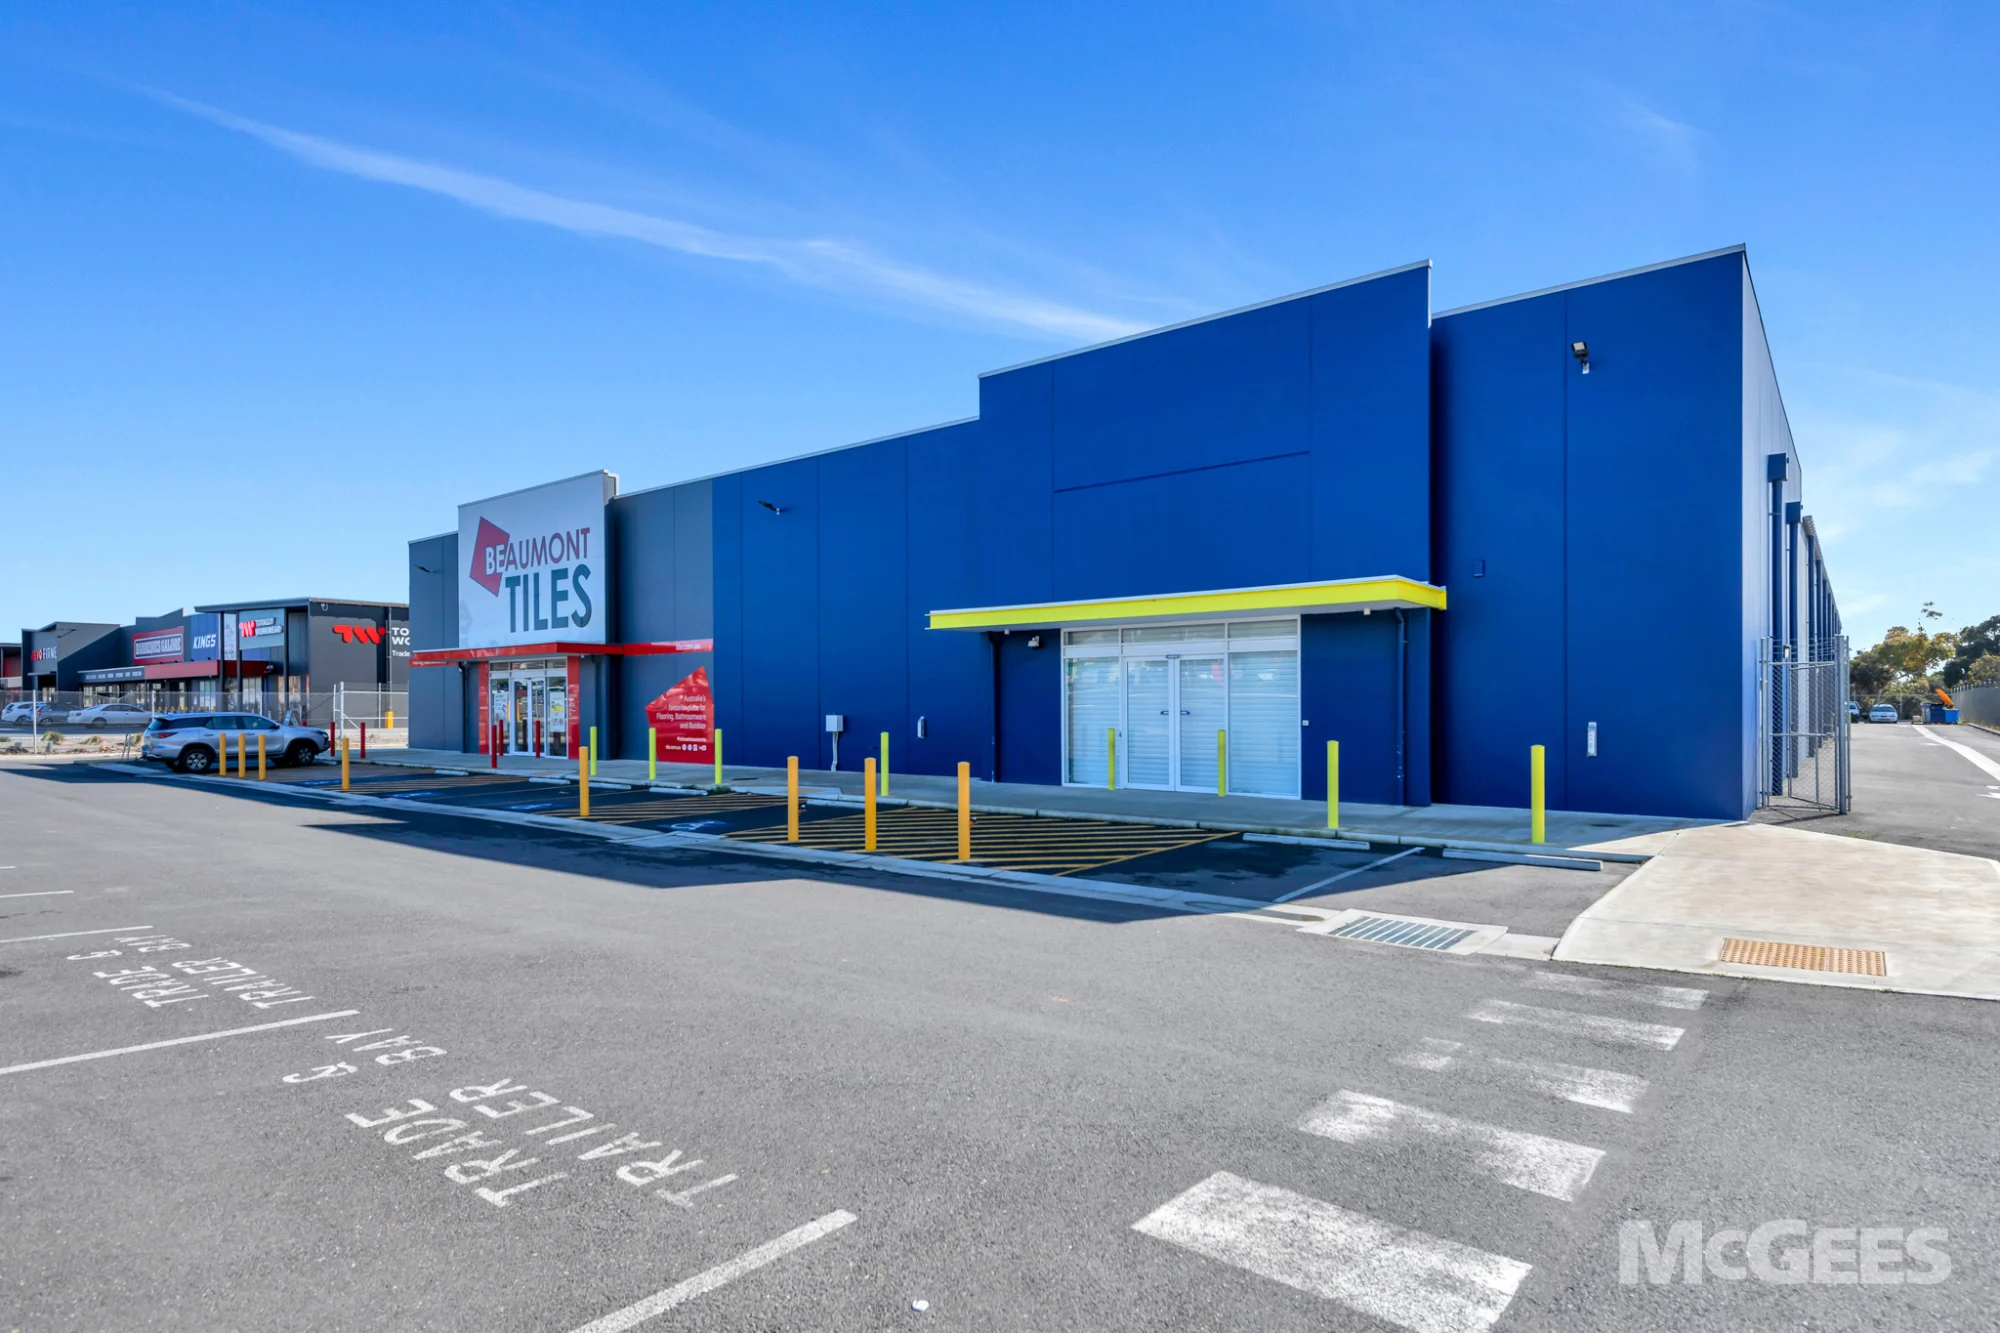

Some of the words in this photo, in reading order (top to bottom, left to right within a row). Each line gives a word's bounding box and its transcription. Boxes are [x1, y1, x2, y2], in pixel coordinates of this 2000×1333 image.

[484, 527, 590, 577] BEAUMONT
[505, 563, 592, 633] TILES
[193, 633, 217, 649] KINGS
[66, 949, 122, 961] &
[113, 934, 193, 953] BAY
[92, 965, 209, 1008] TRADE
[171, 957, 316, 1009] TRAILER
[324, 1027, 448, 1066] BAY
[281, 1061, 359, 1083] &
[344, 1098, 569, 1207] TRADE
[448, 1077, 739, 1208] TRAILER
